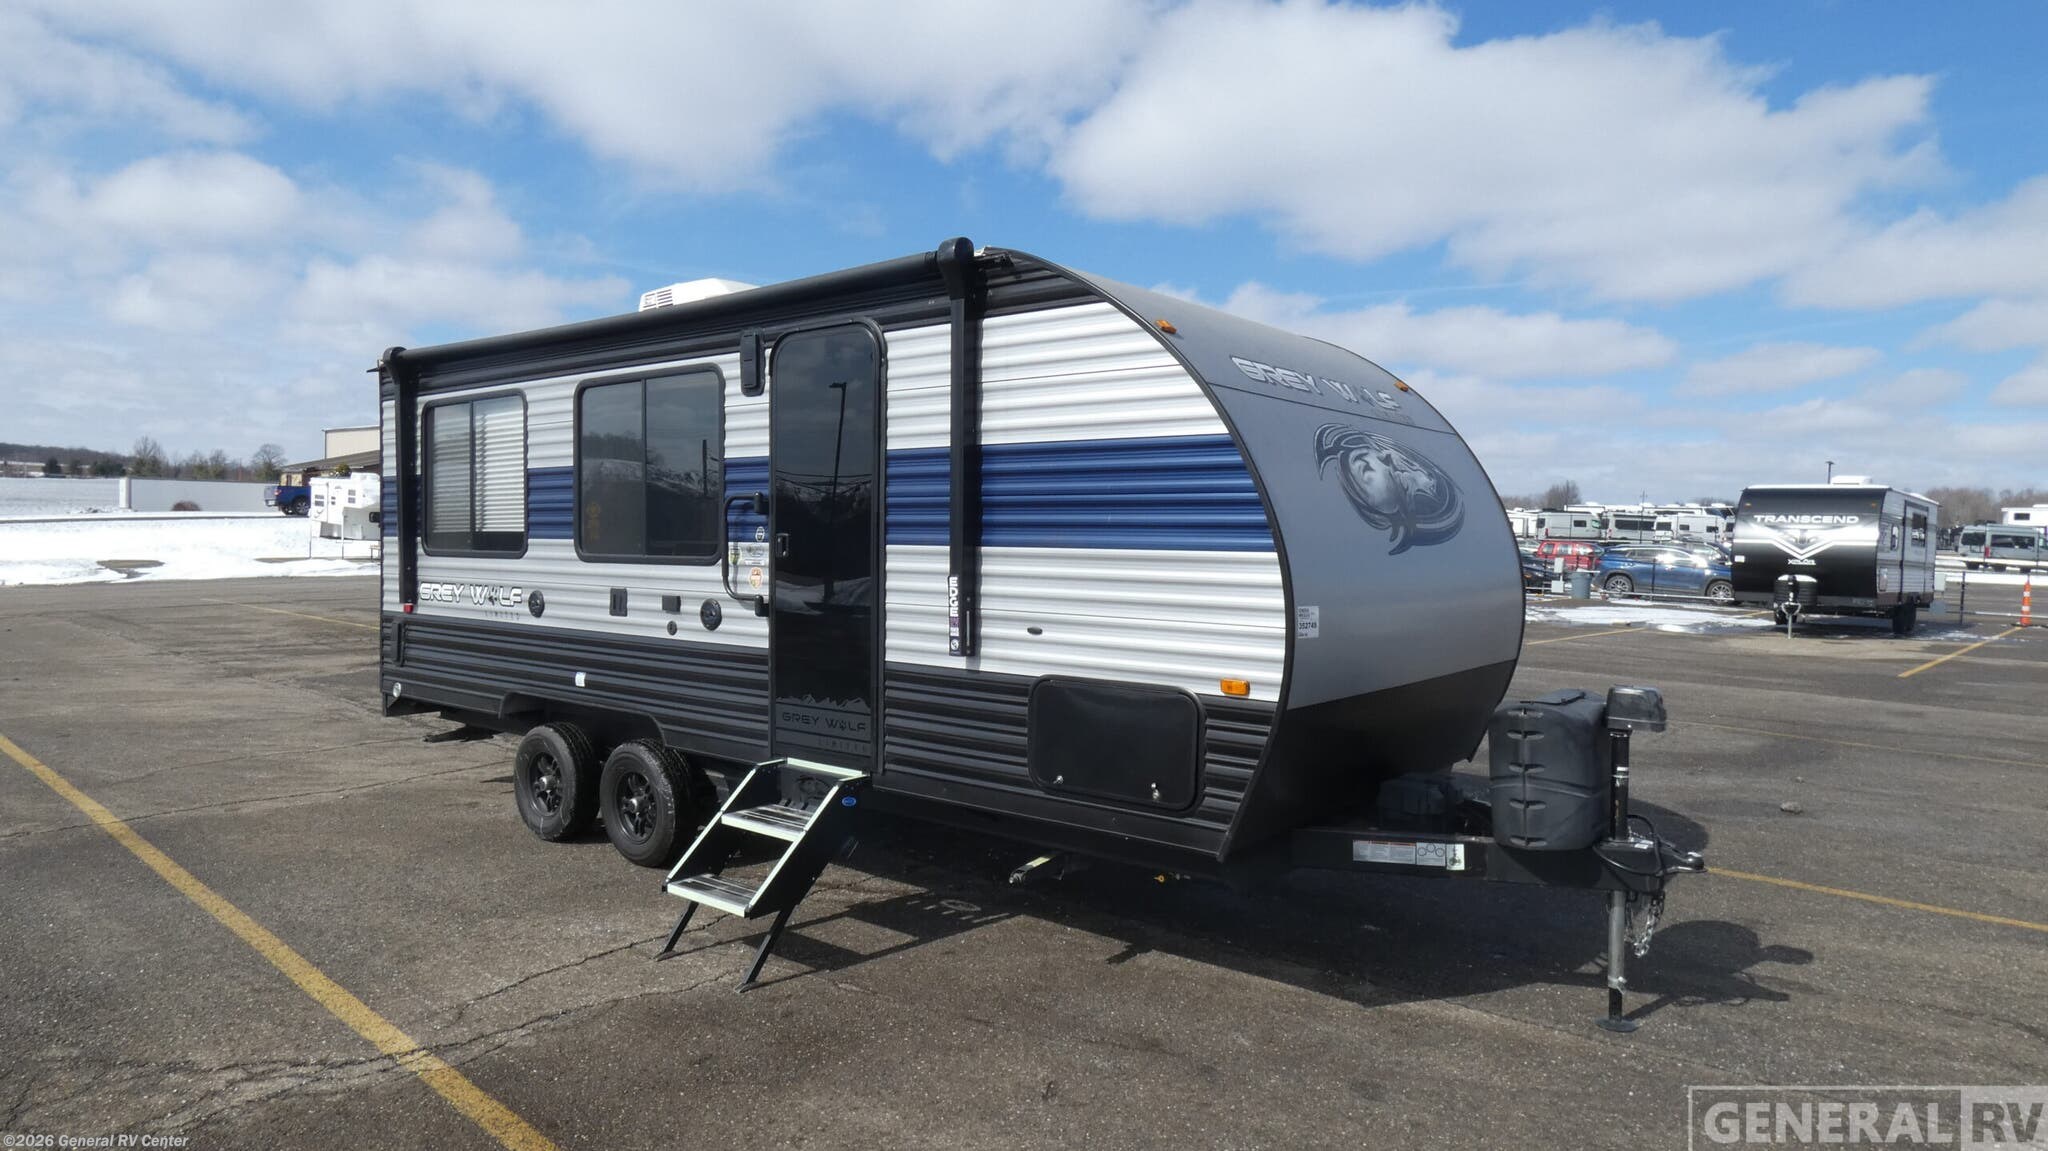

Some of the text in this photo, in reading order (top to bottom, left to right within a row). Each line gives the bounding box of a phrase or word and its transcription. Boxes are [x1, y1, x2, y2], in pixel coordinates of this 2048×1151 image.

[1231, 356, 1323, 395] GREY
[1753, 514, 1859, 524] TRANSCEND
[419, 581, 464, 602] GREY
[949, 576, 959, 617] EDGE
[782, 711, 820, 726] GREY
